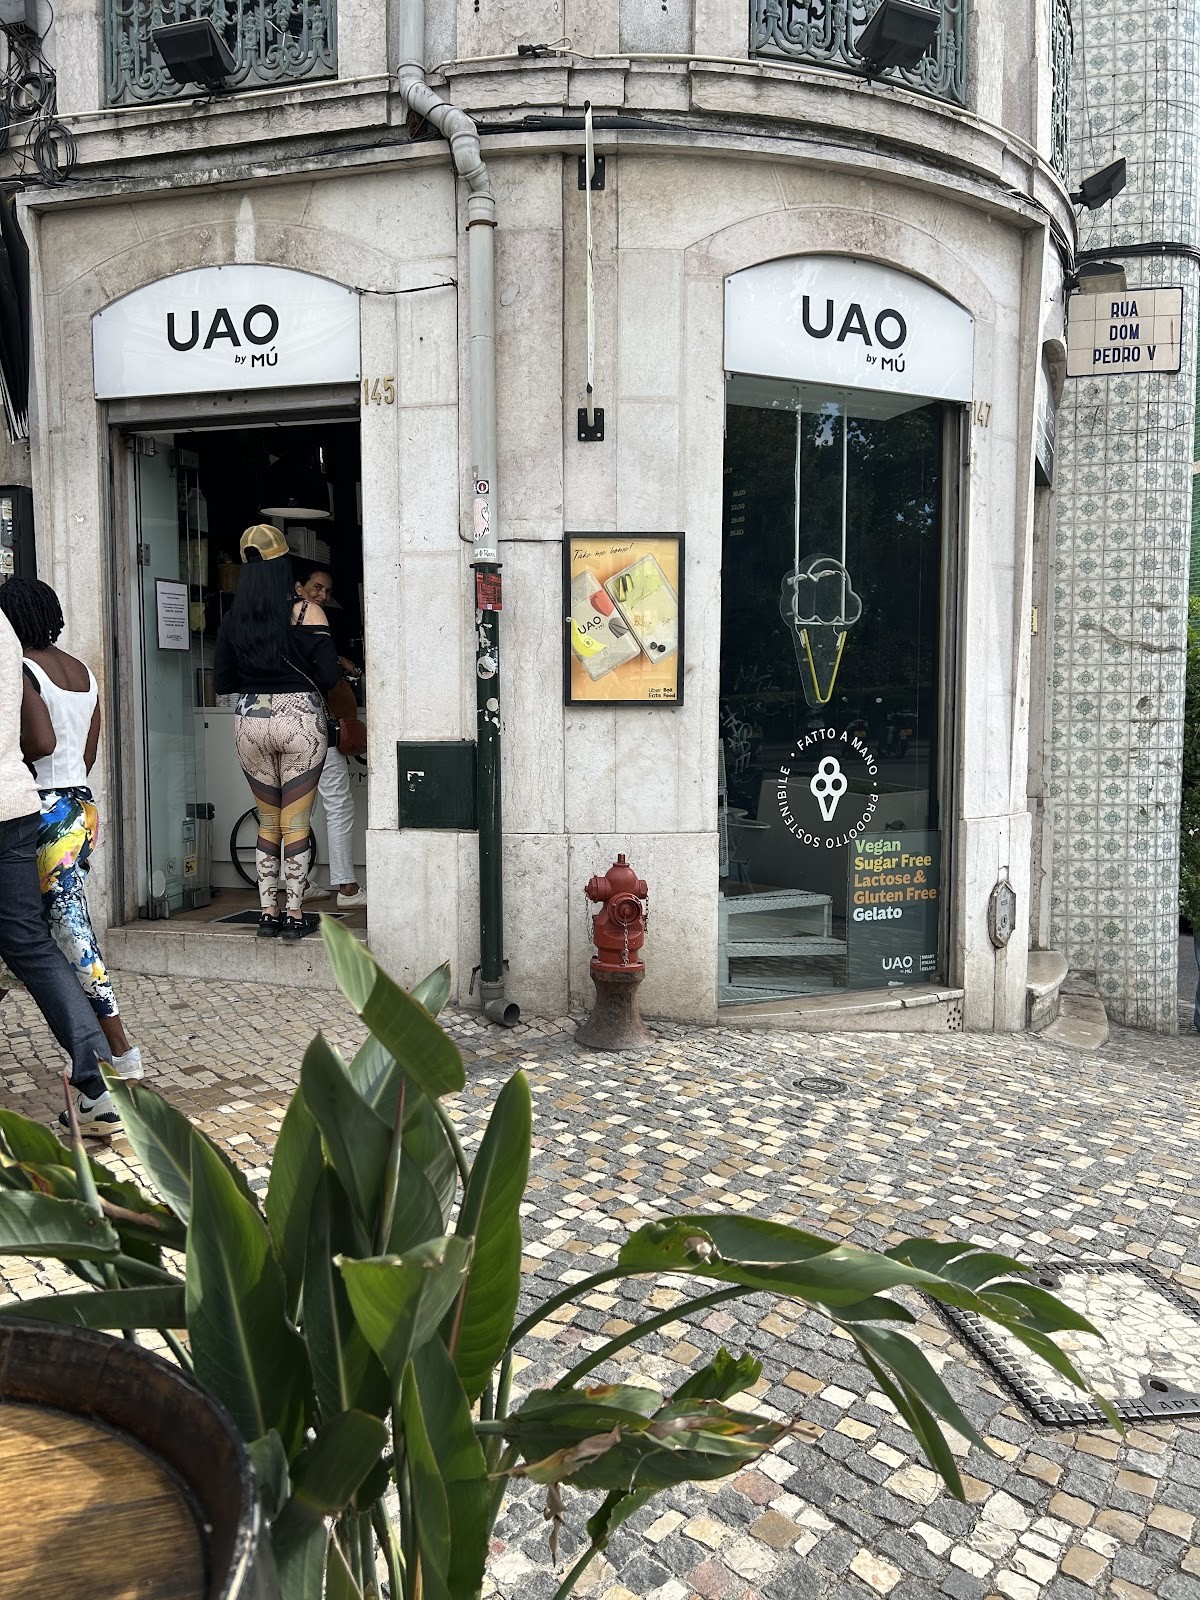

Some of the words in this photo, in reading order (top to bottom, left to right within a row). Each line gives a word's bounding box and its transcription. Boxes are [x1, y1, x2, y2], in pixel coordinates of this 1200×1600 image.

[1111, 301, 1139, 318] RUA
[167, 304, 279, 351] UAO
[802, 295, 907, 350] UAO
[1110, 323, 1139, 341] DOM
[235, 355, 247, 365] by
[251, 346, 278, 368] MÚ
[866, 354, 877, 364] by
[881, 353, 905, 373] MÚ
[1093, 346, 1140, 365] PEDRO
[1147, 345, 1156, 361] V
[363, 374, 395, 405] 145
[973, 400, 992, 428] 147
[573, 549, 592, 560] Take
[577, 616, 602, 634] UAO
[796, 728, 836, 751] FATTO
[840, 730, 848, 742] A
[851, 737, 878, 775] MANO
[777, 765, 821, 848] SOSTENIBILE
[825, 793, 879, 849] PRODOTTO
[855, 839, 901, 855] Vegan
[854, 856, 899, 872] Sugar
[901, 854, 932, 868] Free
[854, 873, 911, 887] Lactose
[913, 870, 927, 884] &
[853, 890, 904, 905] Gluten
[906, 887, 937, 900] Free
[853, 906, 903, 922] Gelato
[882, 955, 913, 970] UAO
